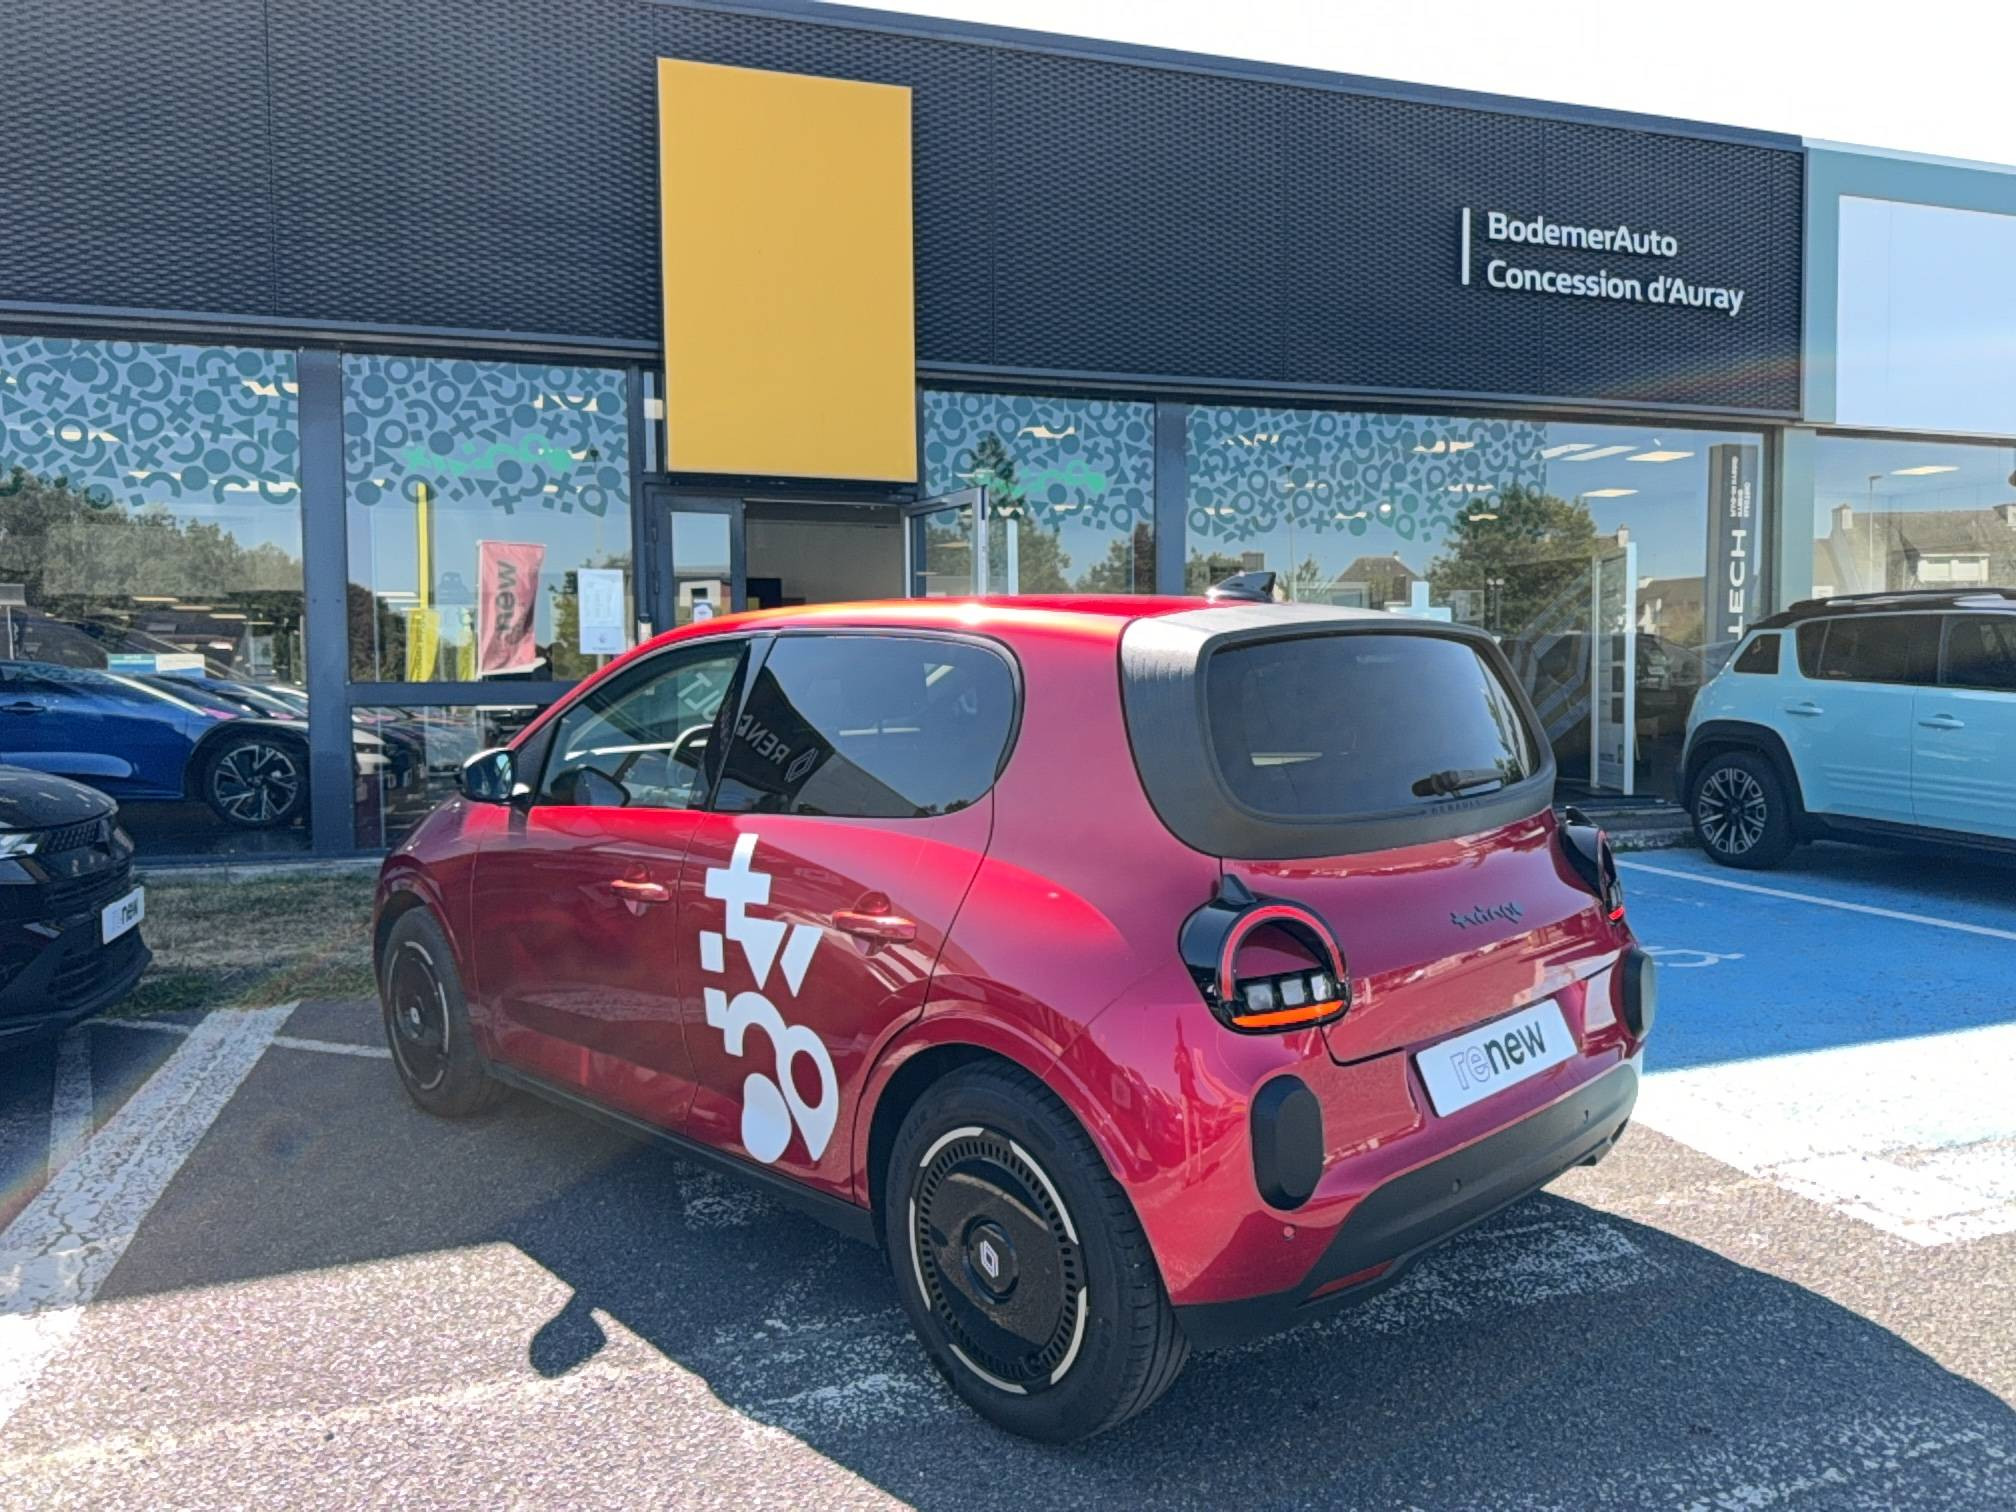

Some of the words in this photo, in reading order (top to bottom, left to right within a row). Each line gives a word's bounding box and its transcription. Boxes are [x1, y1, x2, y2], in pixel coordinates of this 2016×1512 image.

[1488, 211, 1678, 257] BodemerAuto
[1487, 260, 1643, 300] Concession
[1648, 275, 1744, 317] d'Auray
[1451, 1021, 1547, 1090] renew
